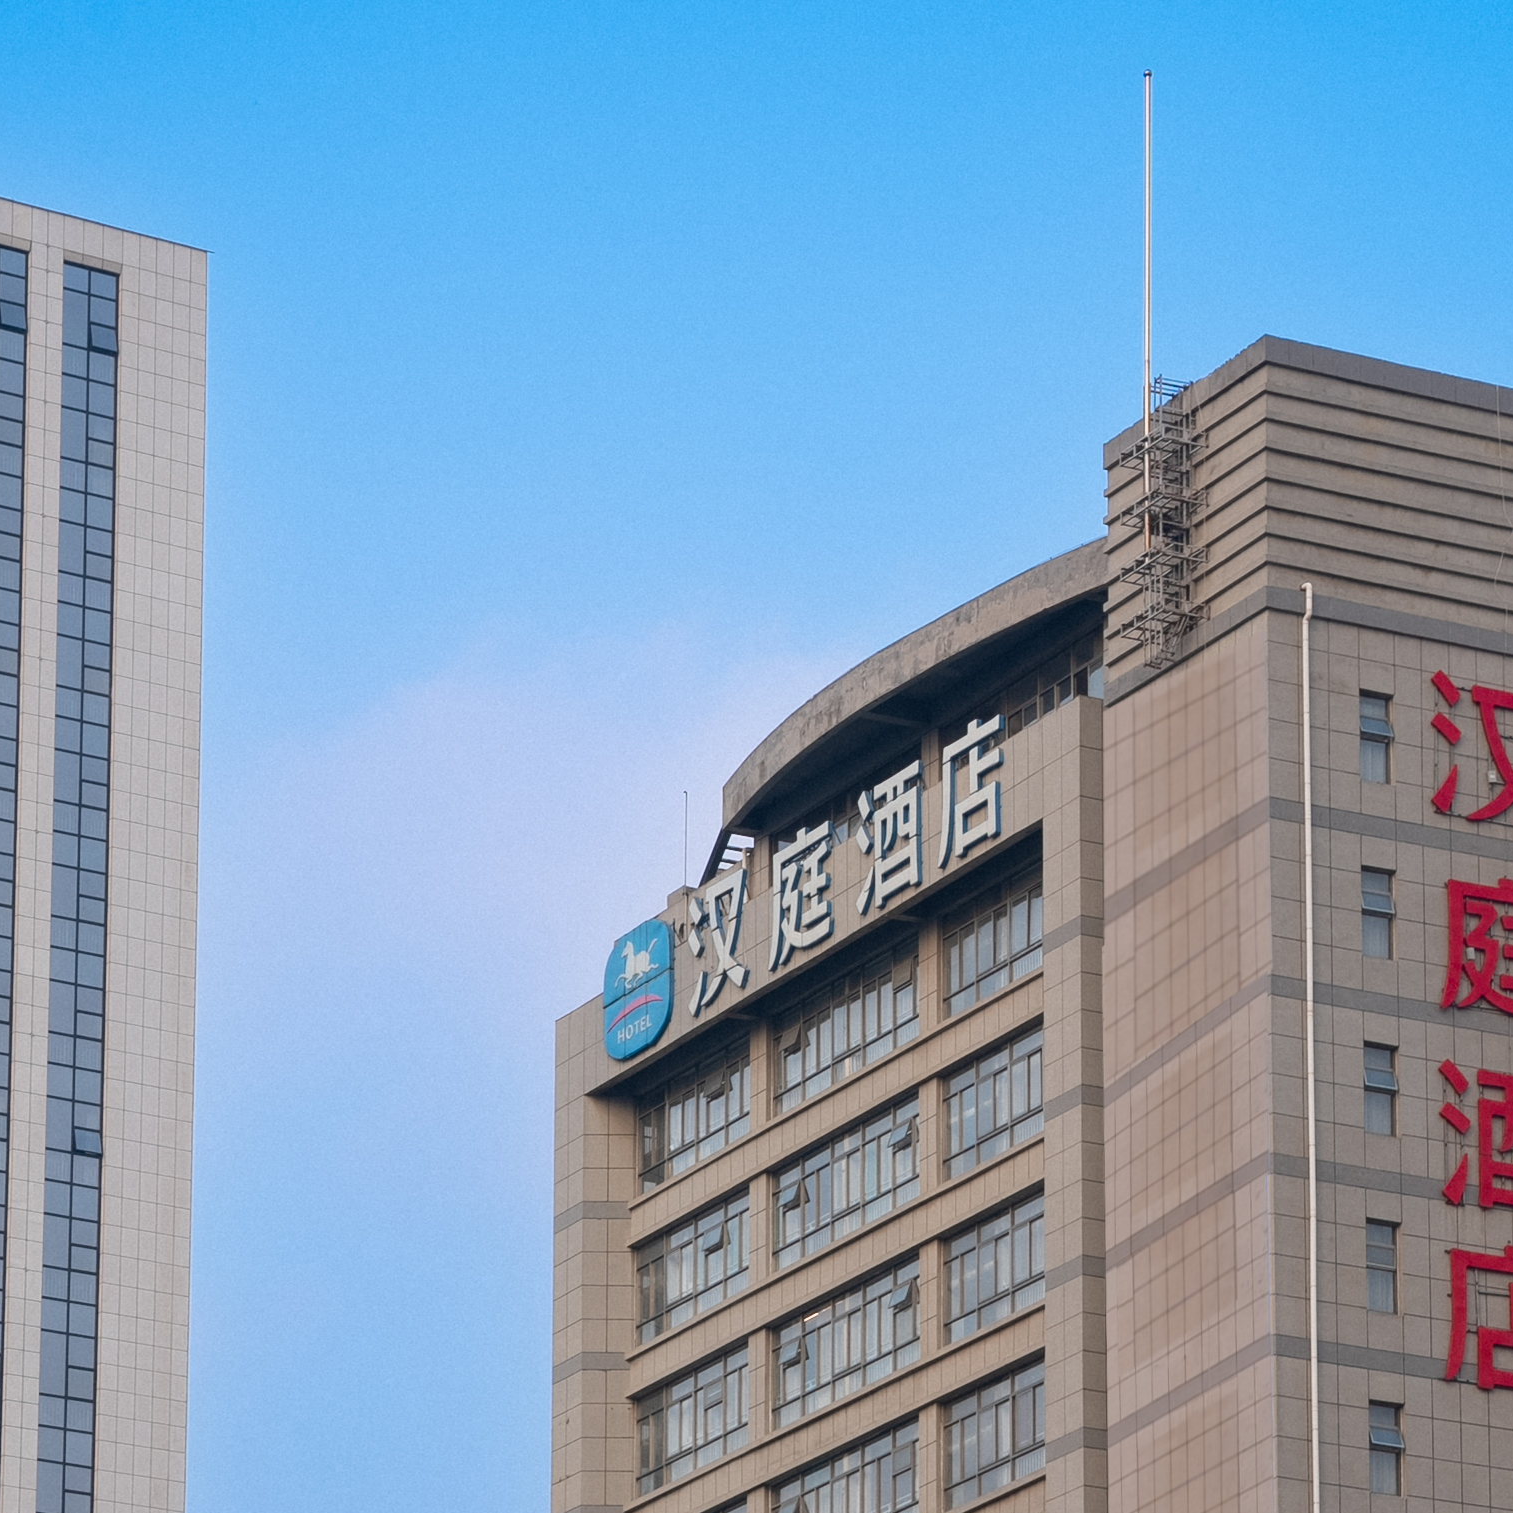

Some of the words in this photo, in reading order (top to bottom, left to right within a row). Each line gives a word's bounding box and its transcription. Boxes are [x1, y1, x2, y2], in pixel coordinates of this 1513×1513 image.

[688, 715, 1005, 1017] 汉庭酒店
[617, 1014, 653, 1045] HOTEL
